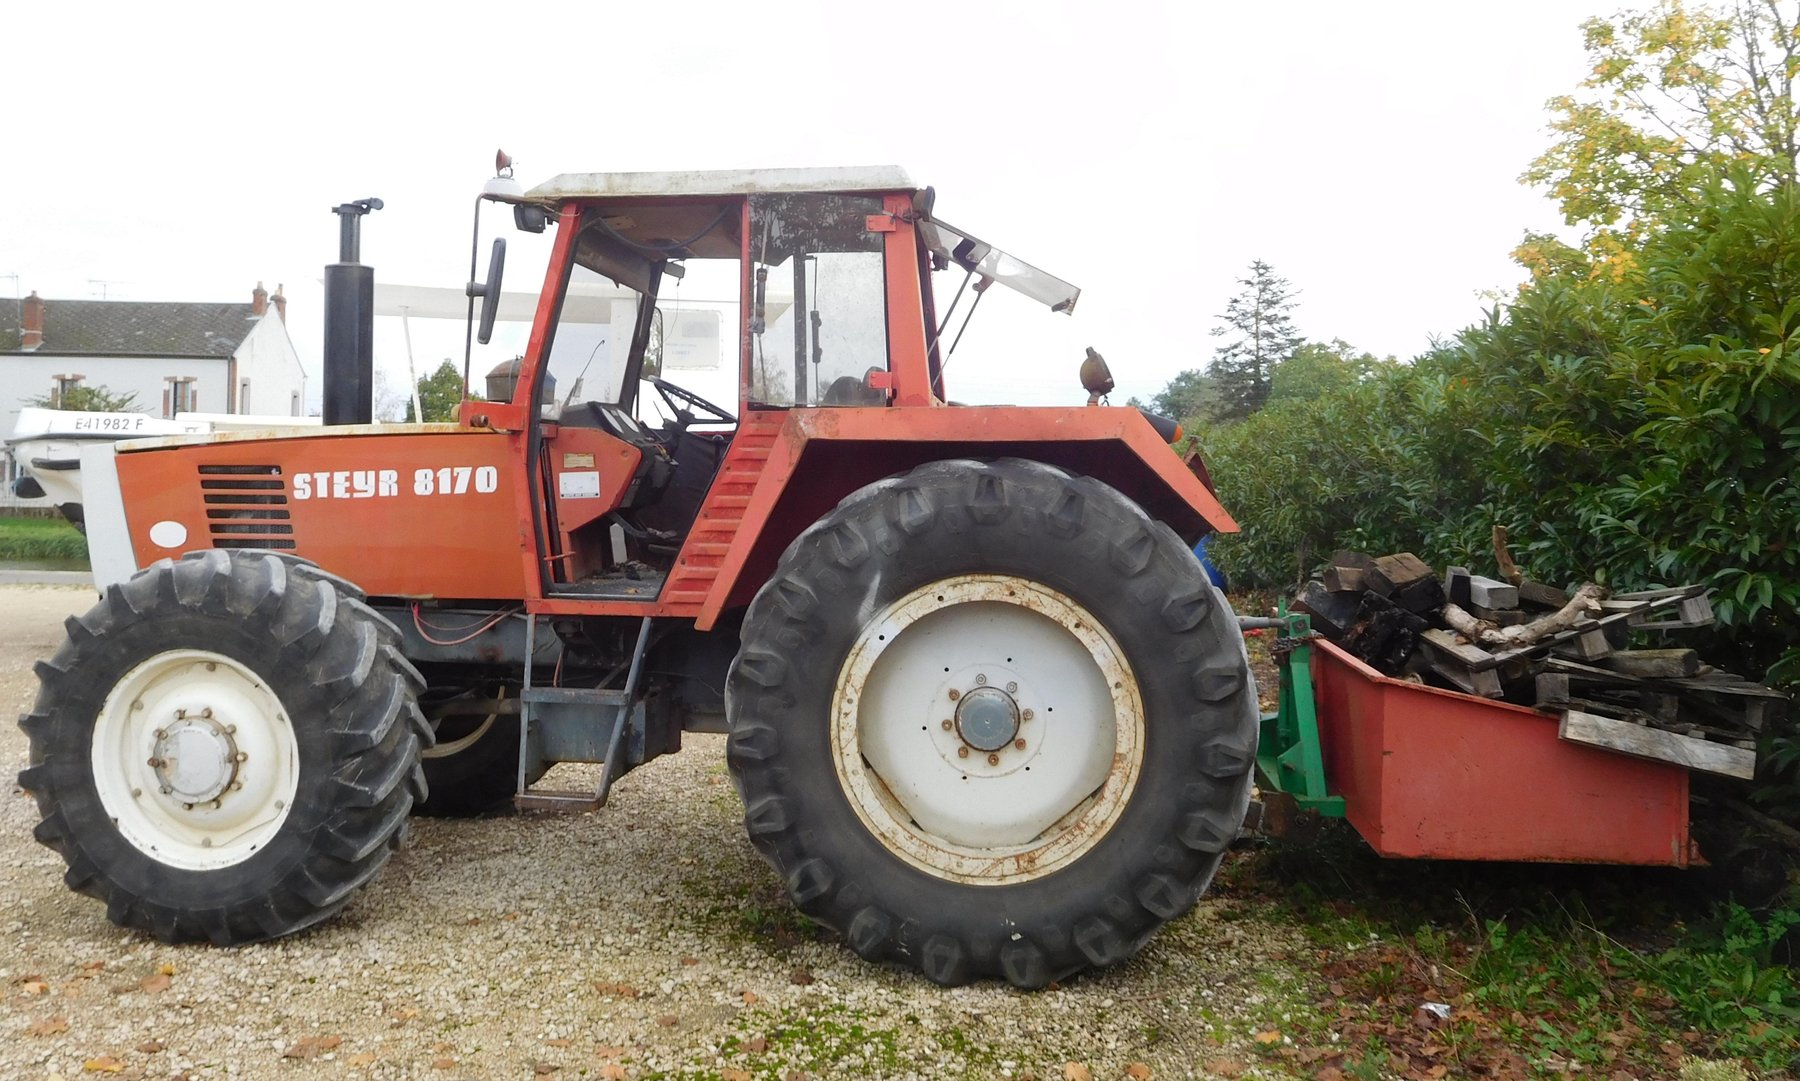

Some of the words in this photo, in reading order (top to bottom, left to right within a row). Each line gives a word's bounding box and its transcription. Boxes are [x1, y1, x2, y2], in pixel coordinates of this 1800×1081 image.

[135, 418, 144, 430] F
[293, 469, 398, 500] STEYR
[413, 465, 498, 496] 8170
